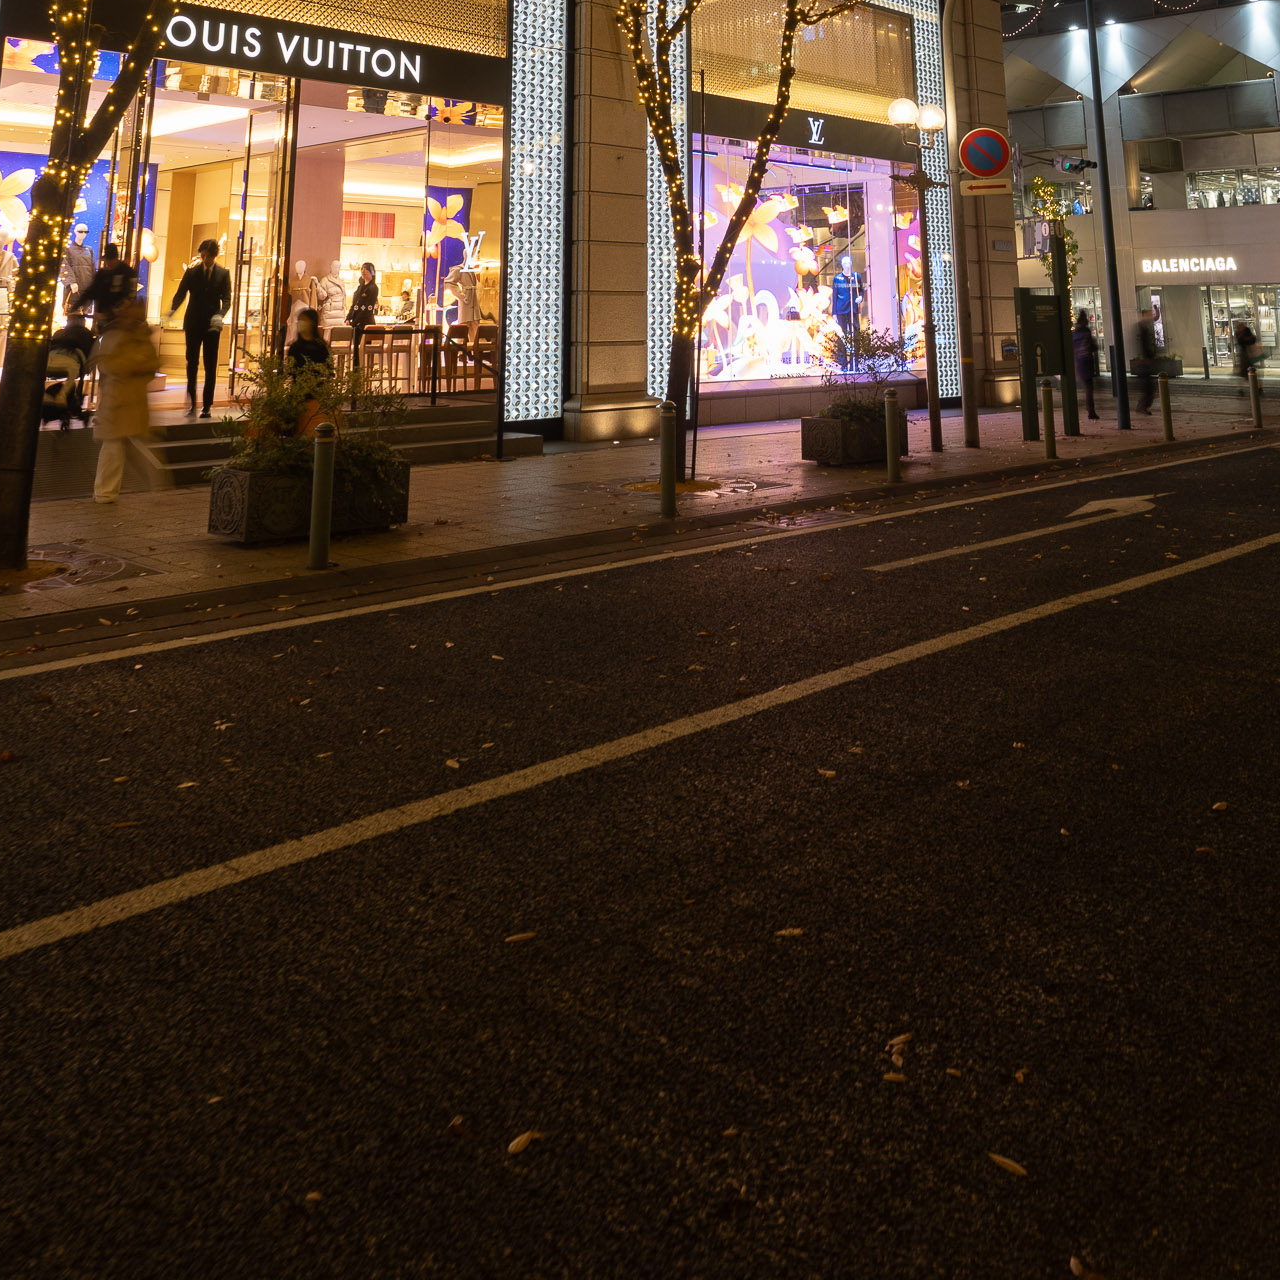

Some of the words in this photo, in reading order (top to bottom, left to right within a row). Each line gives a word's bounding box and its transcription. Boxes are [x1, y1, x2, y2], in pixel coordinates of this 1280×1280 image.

[166, 15, 262, 58] OUIS
[277, 32, 421, 83] VUITTON
[1142, 257, 1237, 273] BALENCIAGA
